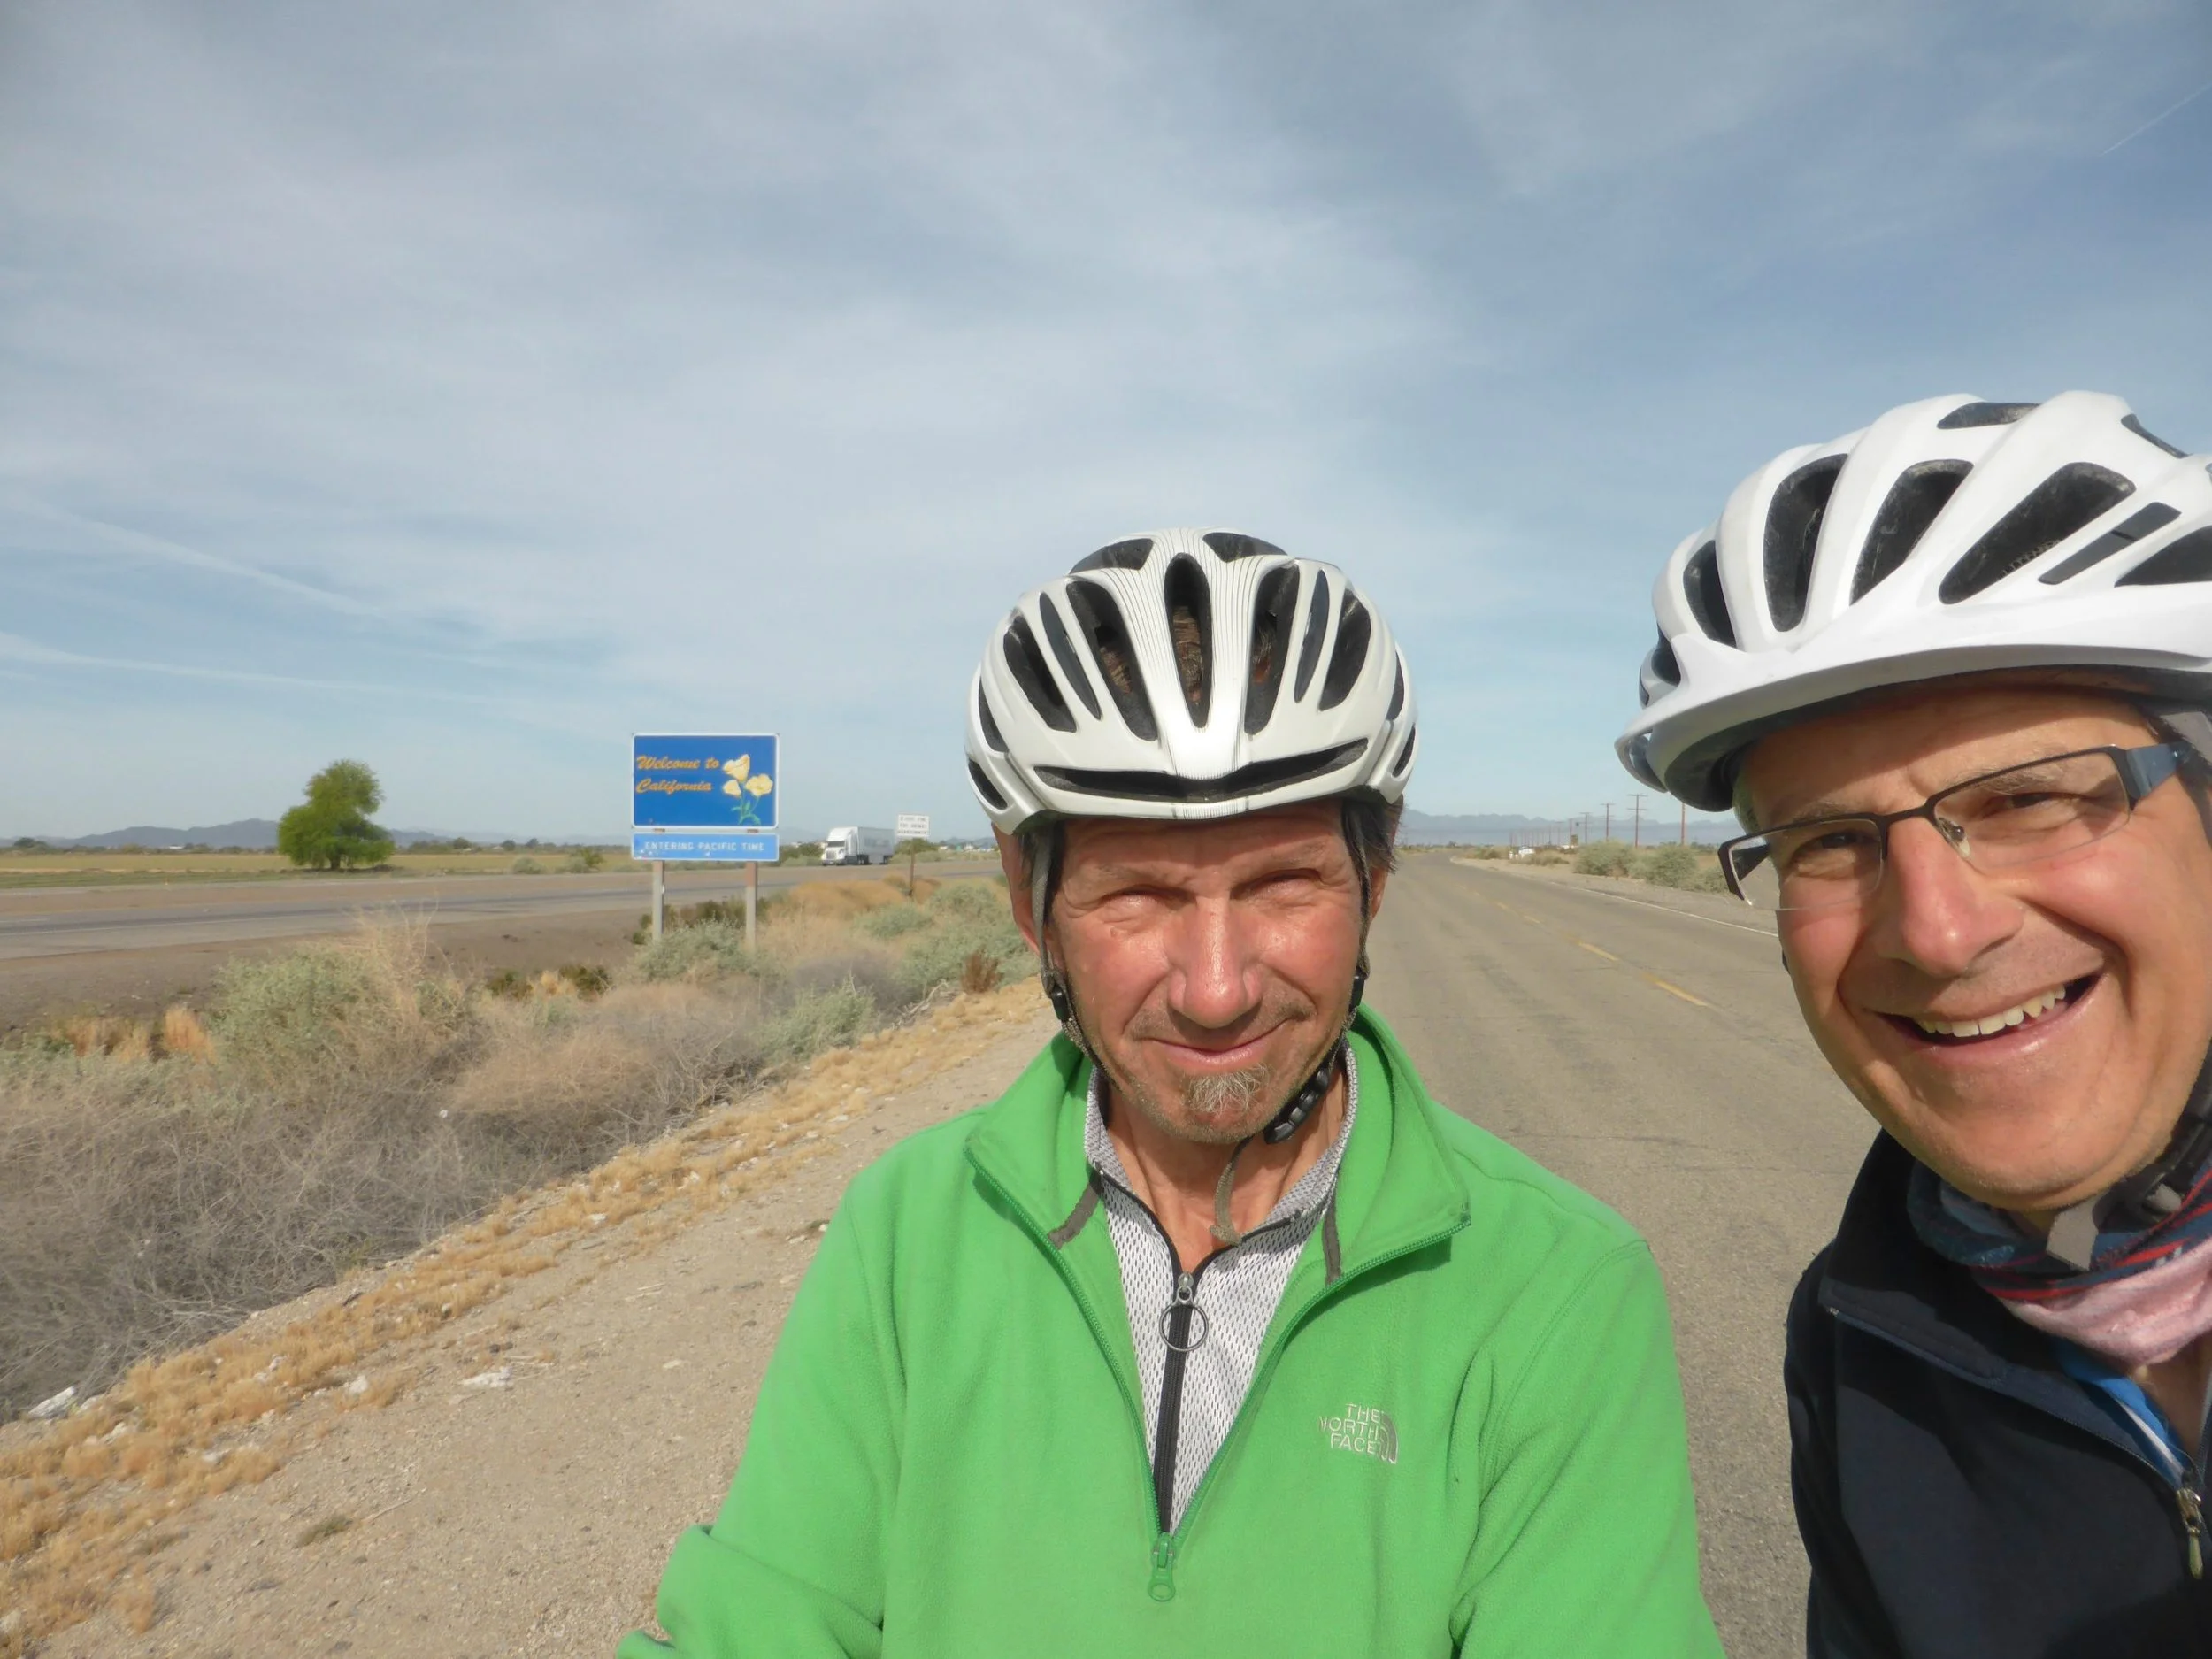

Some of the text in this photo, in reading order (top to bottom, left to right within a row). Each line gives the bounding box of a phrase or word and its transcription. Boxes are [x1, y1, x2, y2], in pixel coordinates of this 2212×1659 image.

[636, 756, 719, 770] Welcome to
[636, 778, 712, 794] California
[645, 841, 694, 850] ENTERING
[742, 842, 764, 851] TIME
[1345, 1403, 1379, 1423] THE
[1330, 1432, 1377, 1455] FACE
